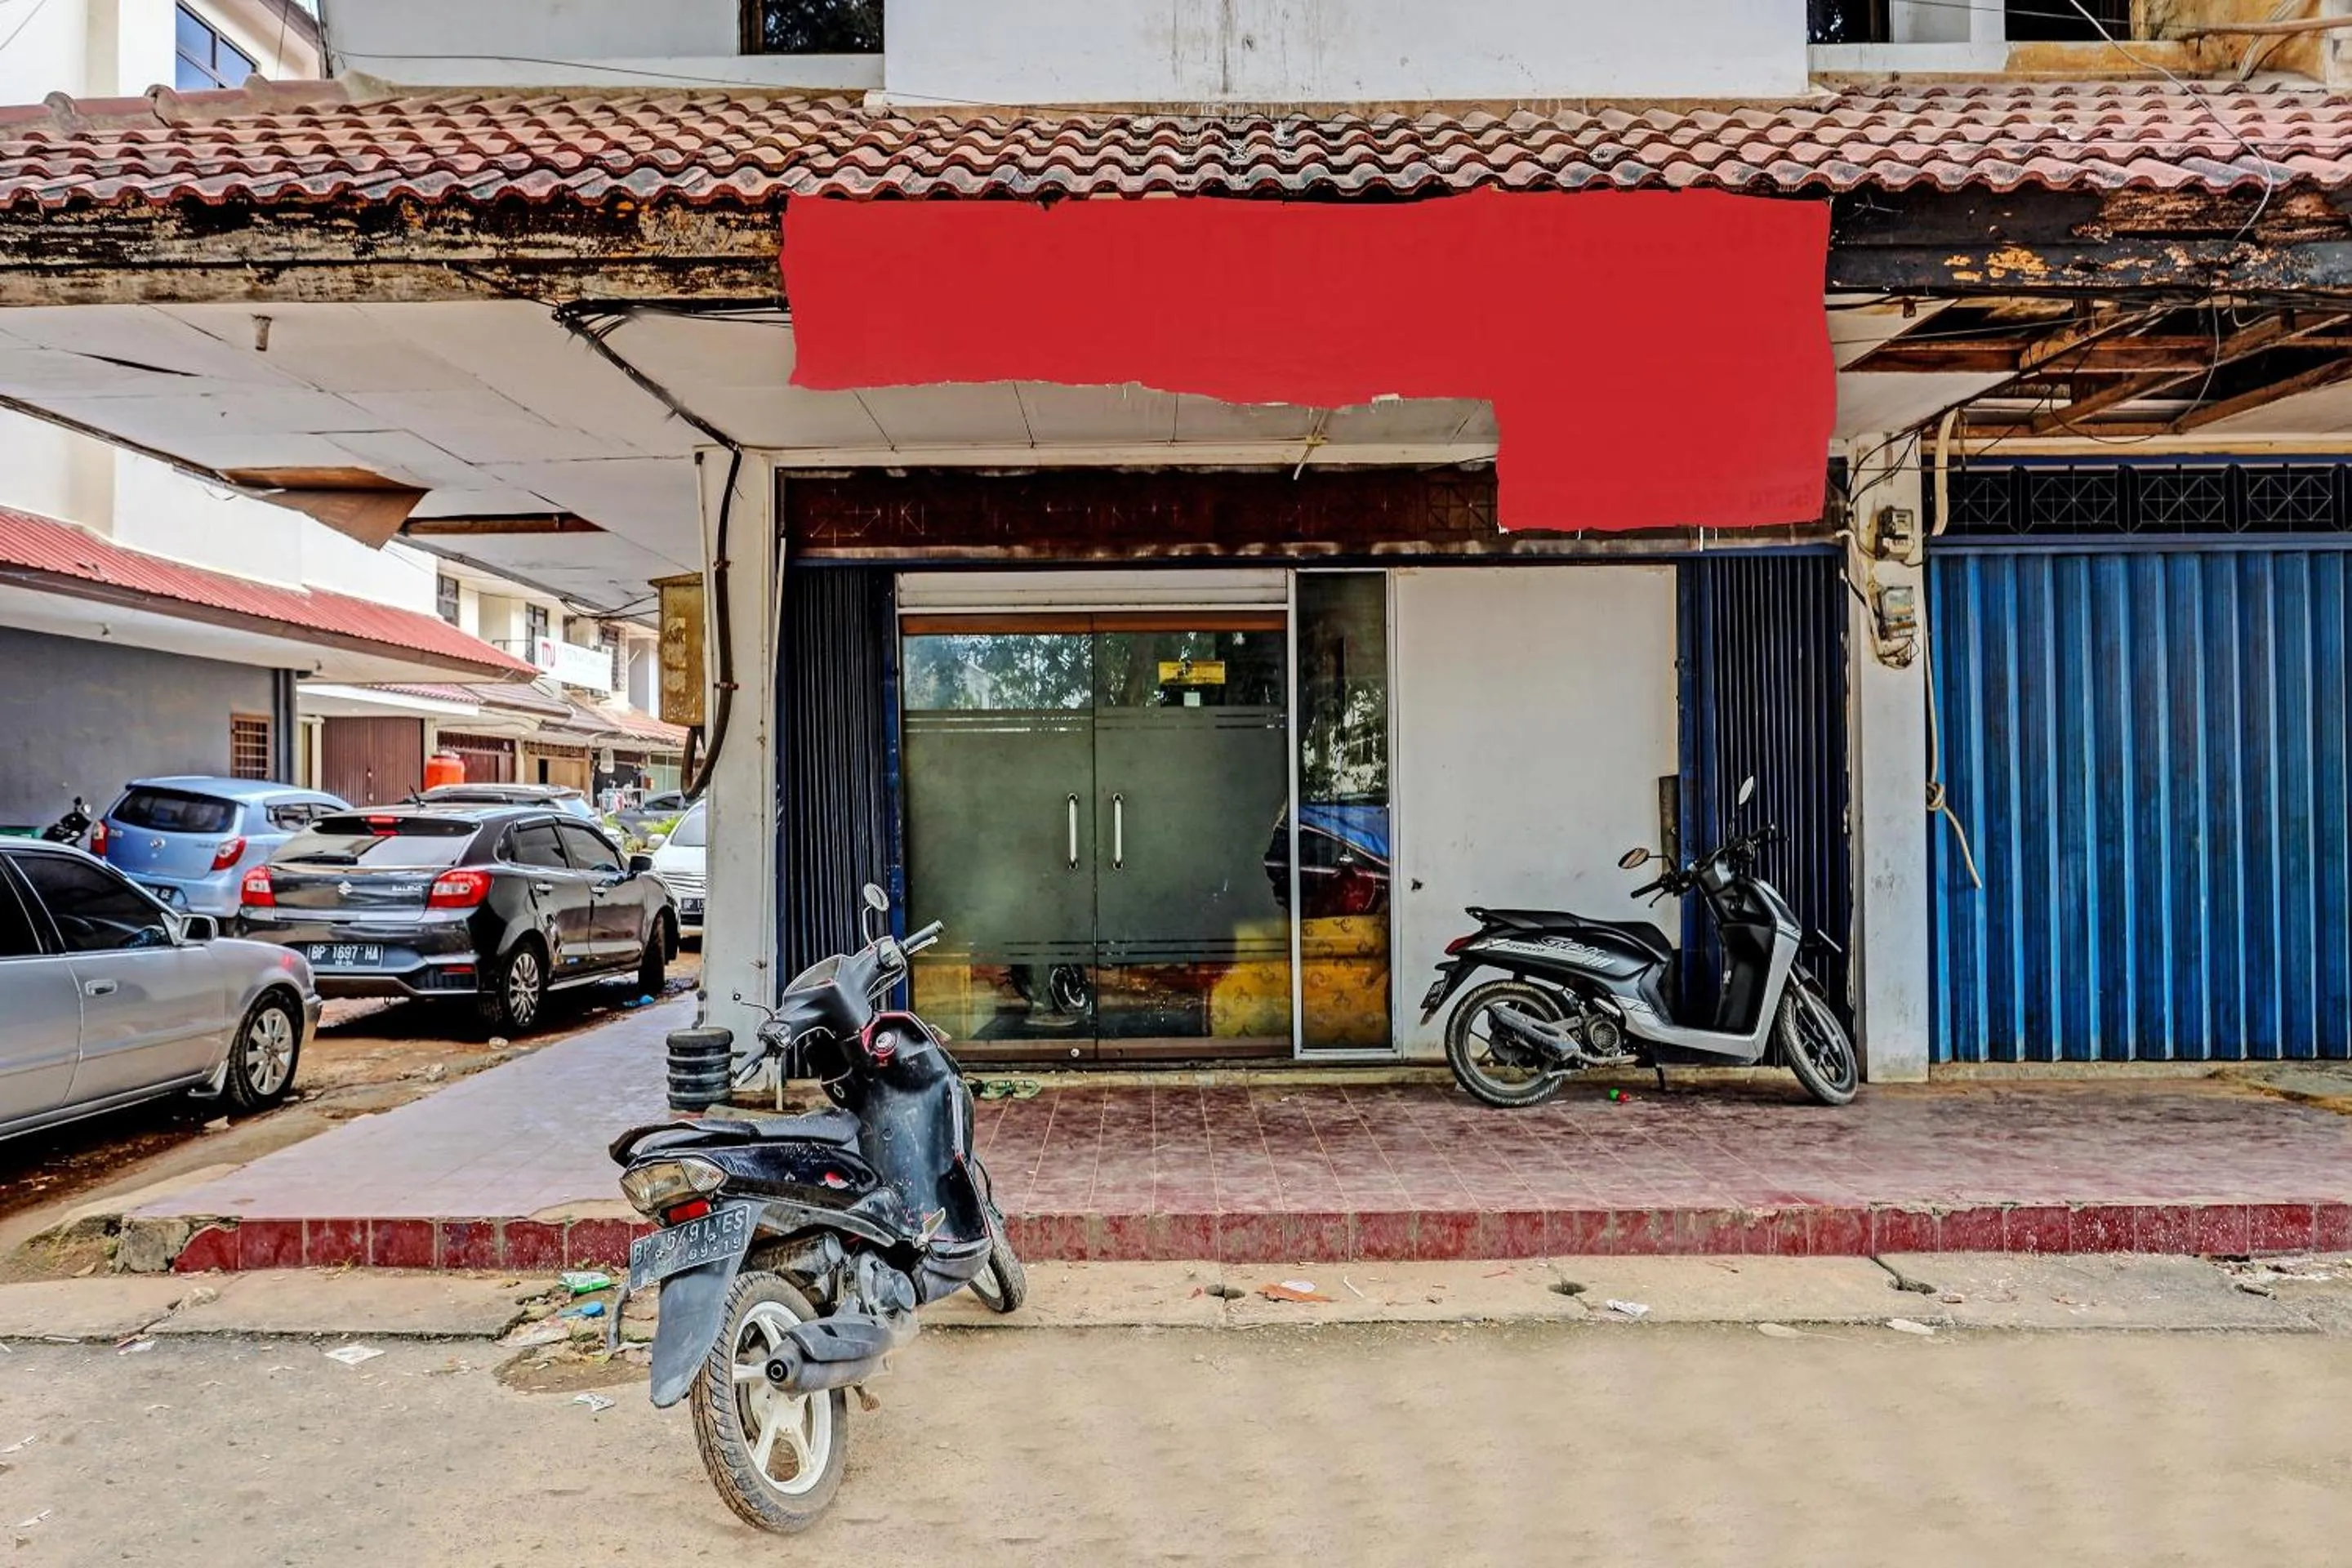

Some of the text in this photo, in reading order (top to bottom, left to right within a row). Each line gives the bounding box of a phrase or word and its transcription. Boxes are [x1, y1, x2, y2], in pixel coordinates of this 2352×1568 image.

[311, 945, 378, 960] BP 1697 HA
[634, 1239, 652, 1263] BP
[723, 1209, 745, 1233] ES
